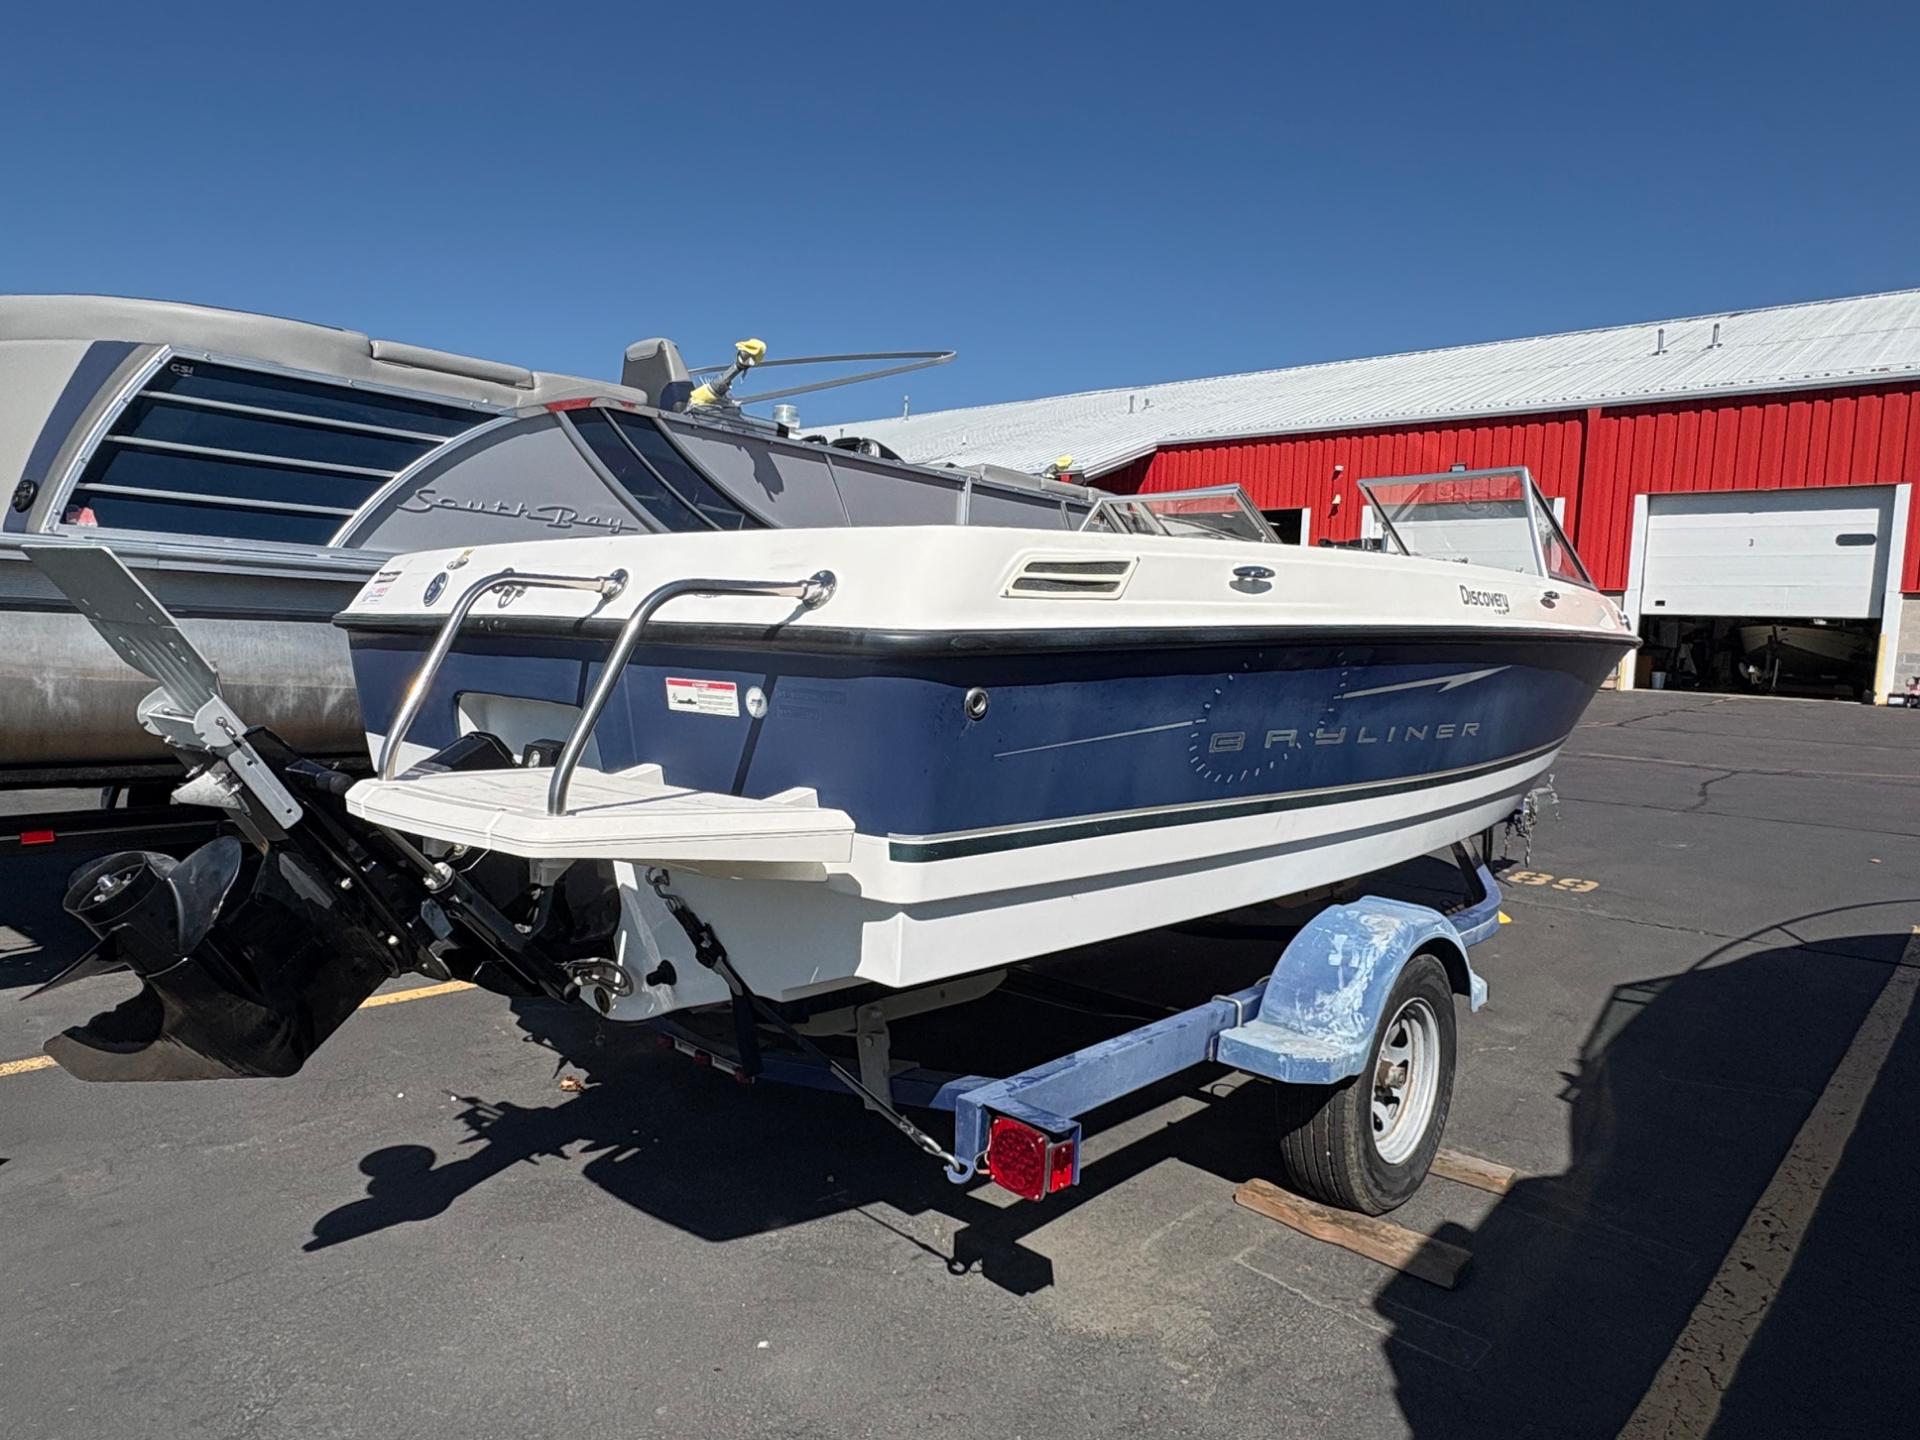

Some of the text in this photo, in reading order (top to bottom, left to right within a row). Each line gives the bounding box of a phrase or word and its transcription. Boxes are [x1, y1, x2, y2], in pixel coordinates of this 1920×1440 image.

[397, 489, 638, 534] South Bay
[1208, 722, 1481, 753] BAYLINER
